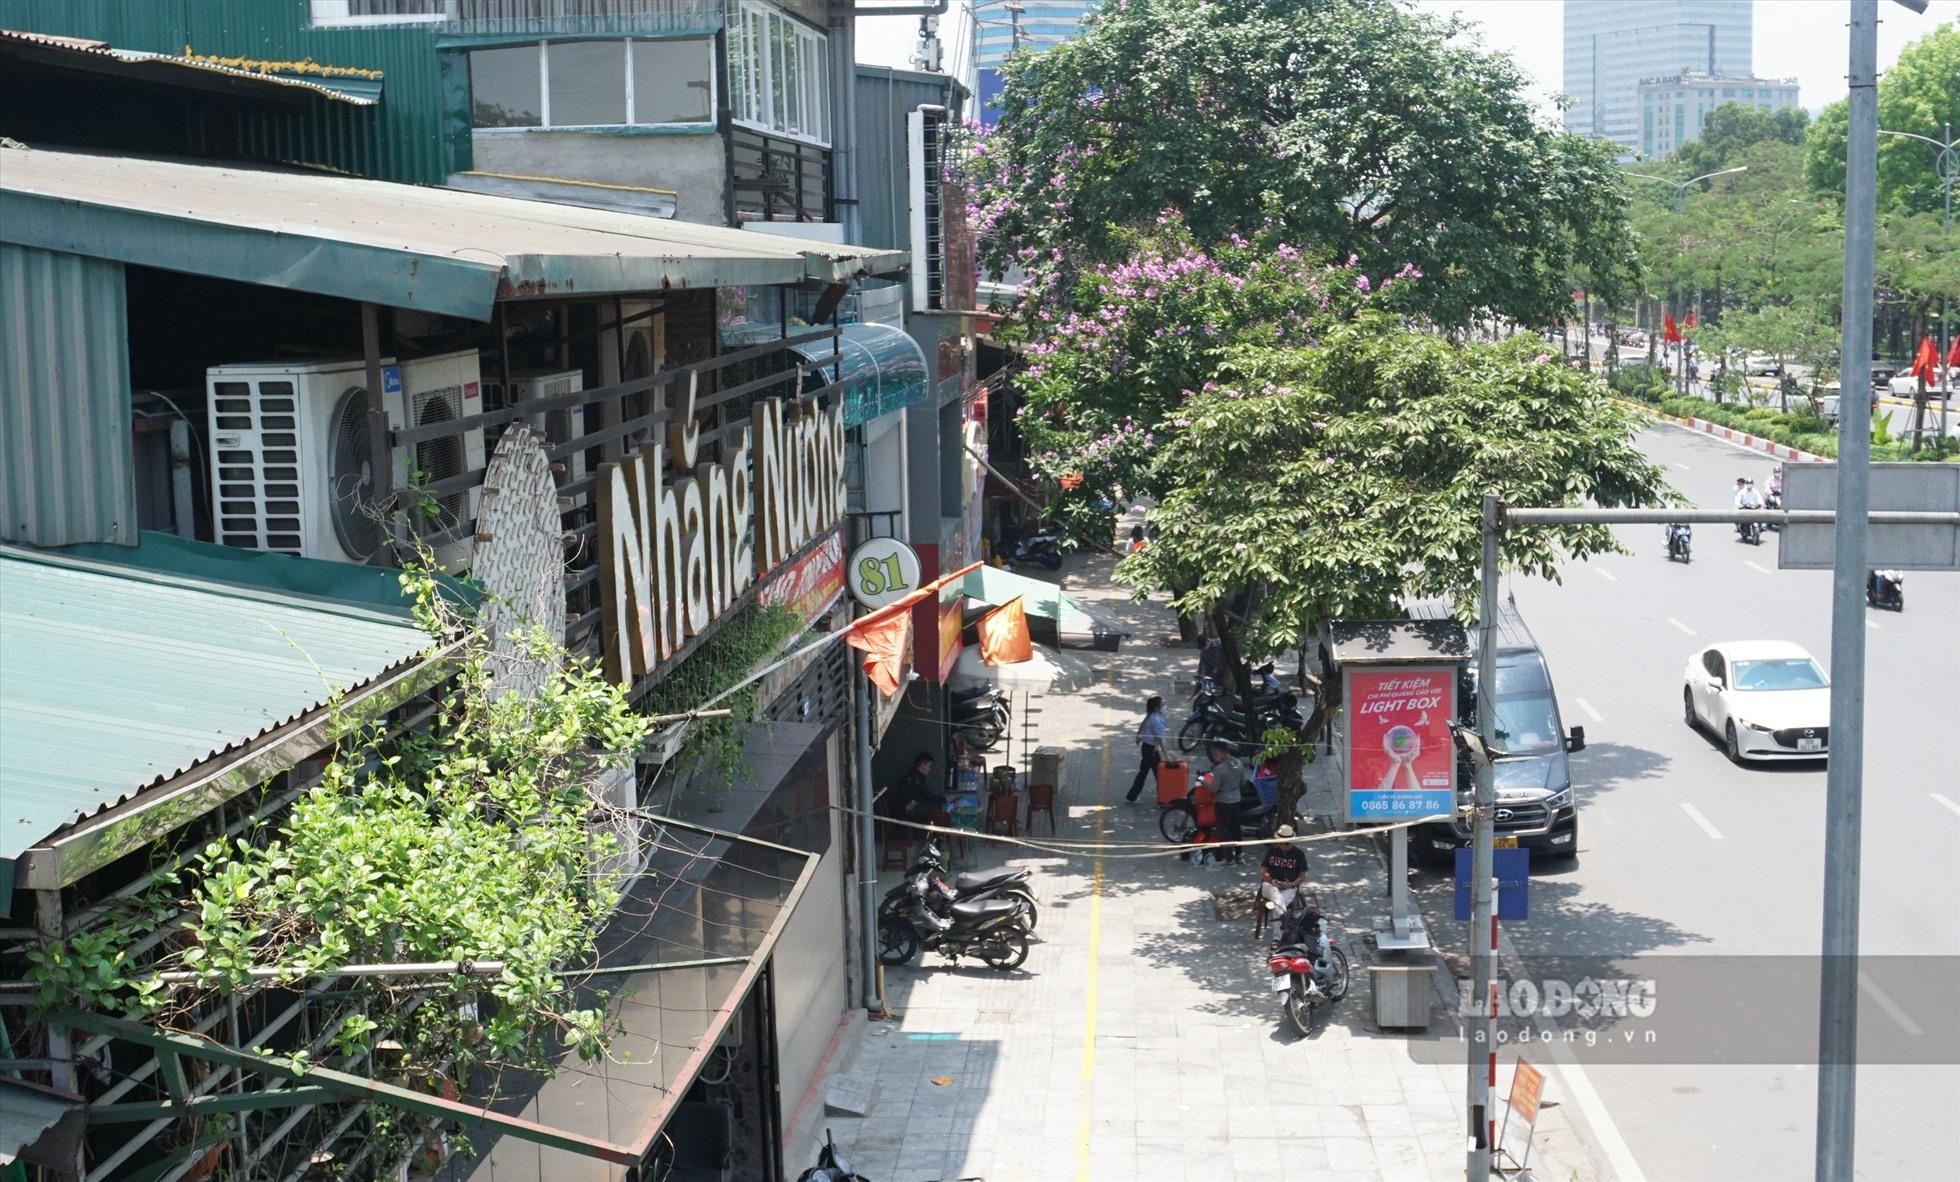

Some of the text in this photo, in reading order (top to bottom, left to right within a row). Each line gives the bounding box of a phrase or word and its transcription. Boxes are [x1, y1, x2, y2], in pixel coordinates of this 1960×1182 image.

[858, 552, 909, 596] 81
[1378, 677, 1431, 691] TIẾT KIỆM
[1360, 696, 1441, 714] LIGHT BOX
[1361, 800, 1440, 810] 0865 86 87 86
